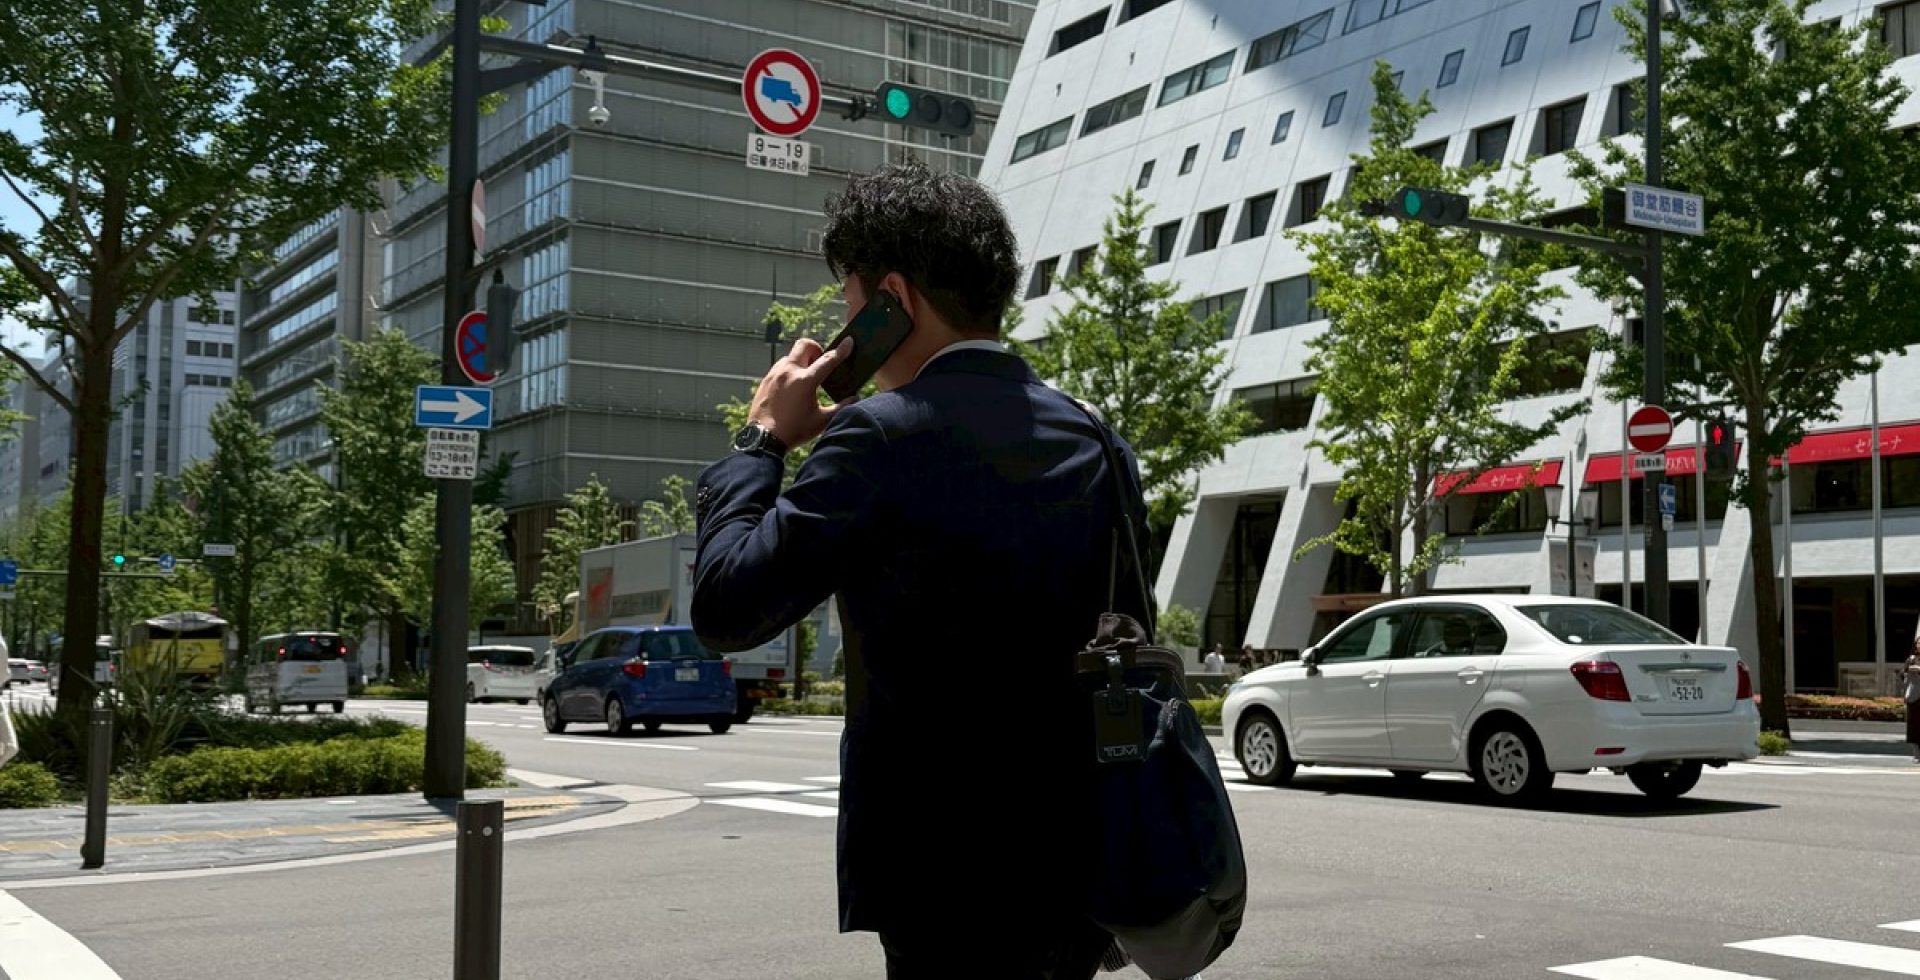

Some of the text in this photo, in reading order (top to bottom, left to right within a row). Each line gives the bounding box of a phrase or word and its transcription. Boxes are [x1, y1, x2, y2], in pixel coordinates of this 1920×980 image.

[428, 464, 473, 477] ここまで
[1103, 744, 1138, 757] TUMI
